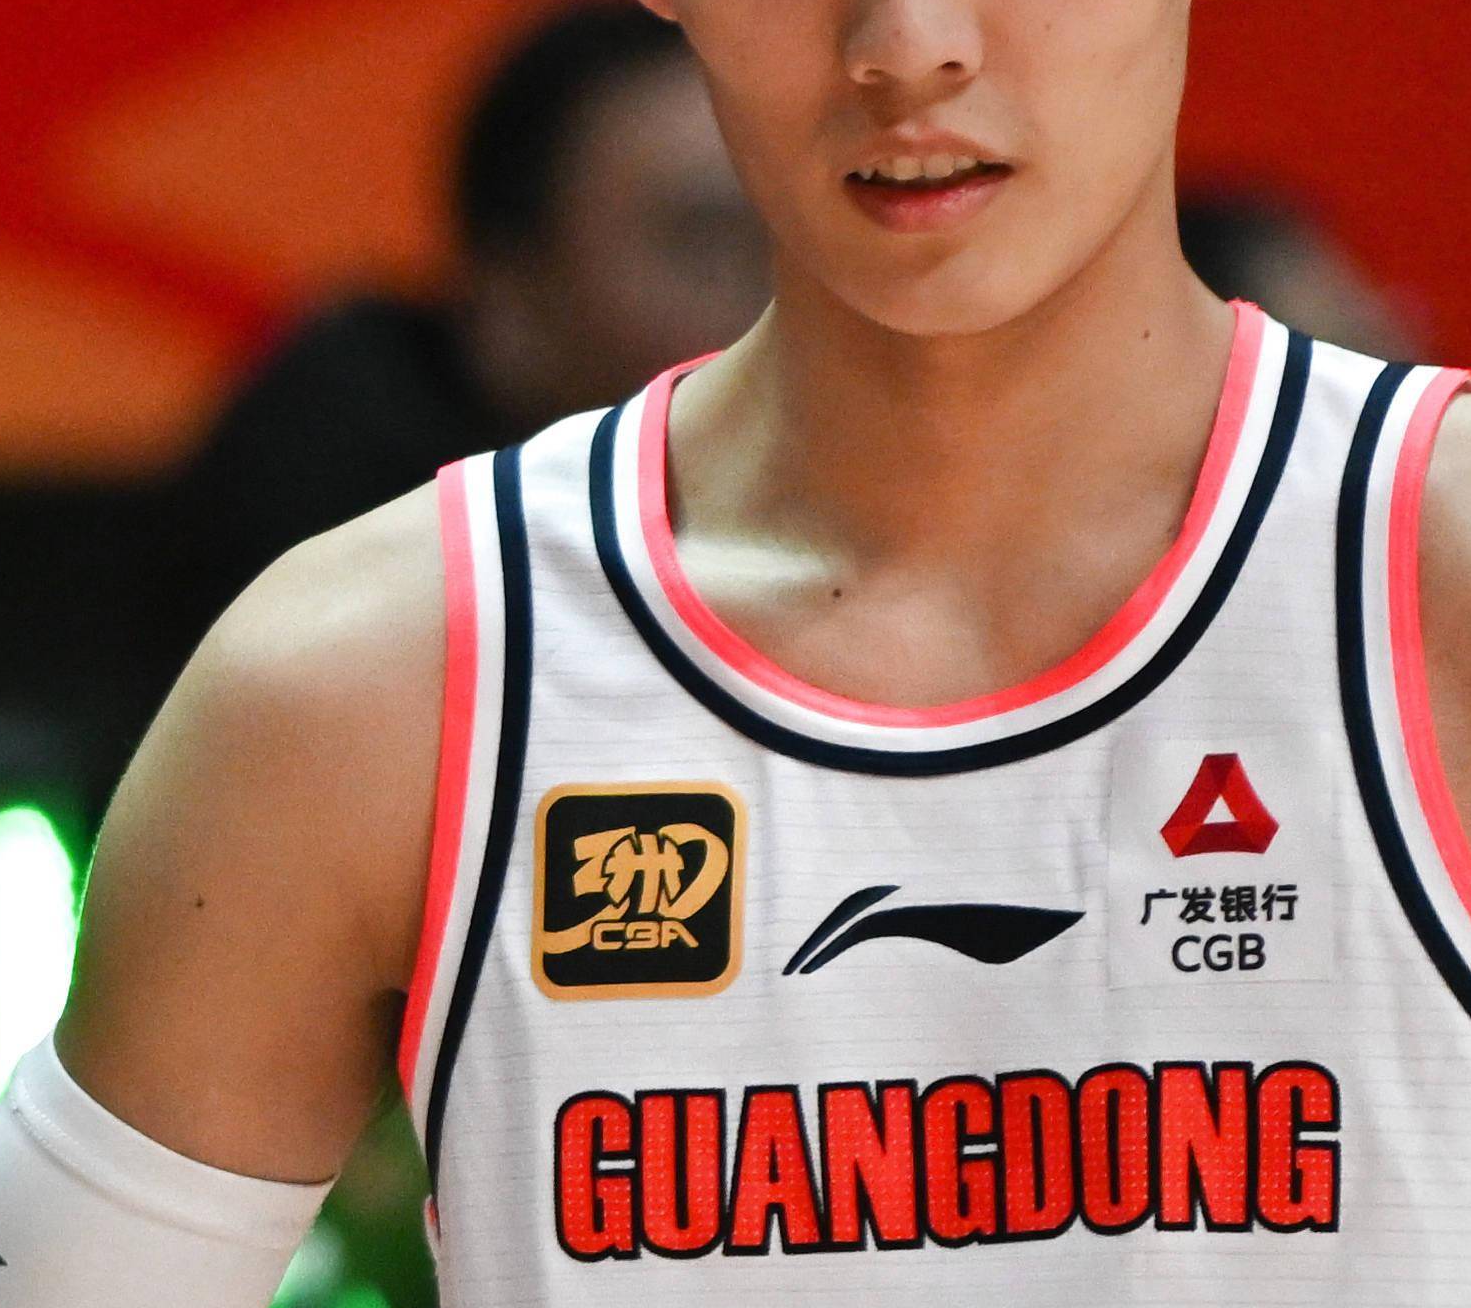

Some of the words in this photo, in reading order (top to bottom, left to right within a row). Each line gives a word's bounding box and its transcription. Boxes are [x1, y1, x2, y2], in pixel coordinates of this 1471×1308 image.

[1140, 883, 1298, 926] 广发银行
[593, 920, 699, 951] CBA
[1171, 932, 1266, 973] CGB
[553, 1060, 1343, 1263] GUANGDONG
